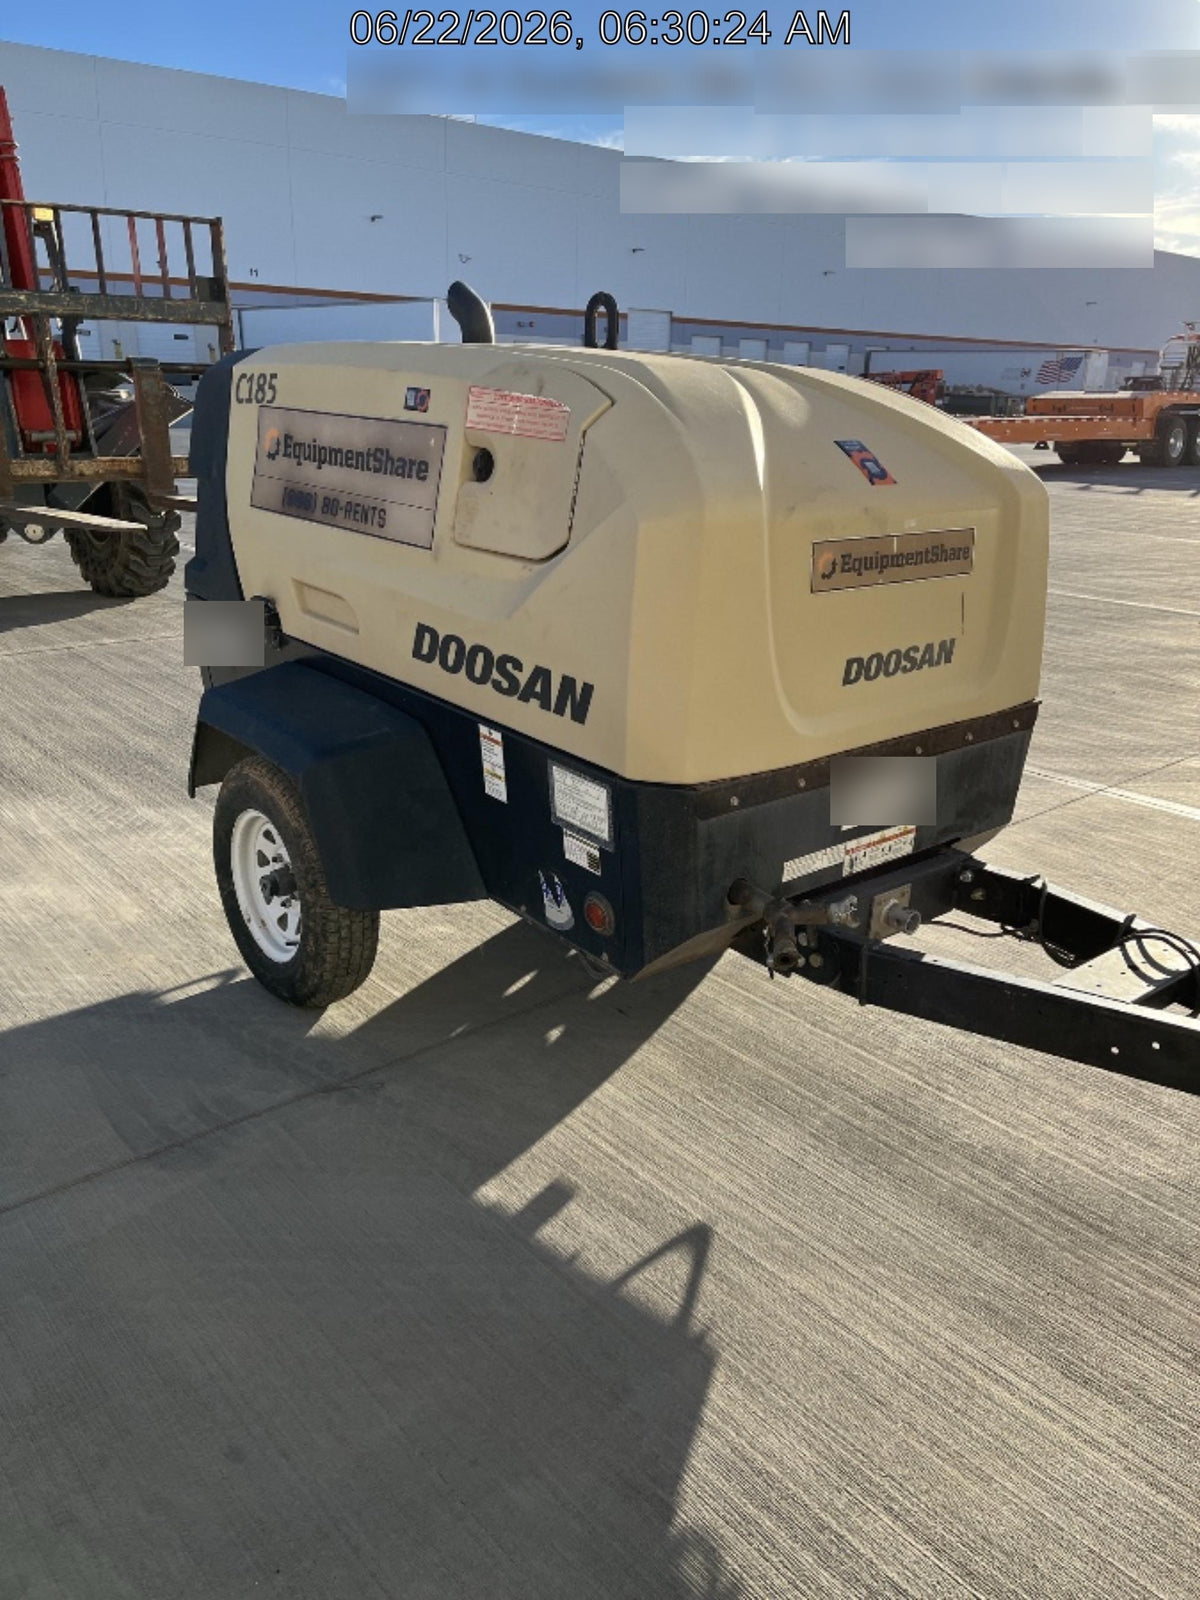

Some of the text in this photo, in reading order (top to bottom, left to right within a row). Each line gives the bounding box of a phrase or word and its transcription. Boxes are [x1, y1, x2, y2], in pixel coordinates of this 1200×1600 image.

[235, 372, 278, 404] C185
[282, 433, 429, 481] EquipmentShare
[840, 544, 970, 576] EquipmentShare
[412, 621, 595, 726] DOOSAN
[841, 637, 957, 688] DOOSAN
